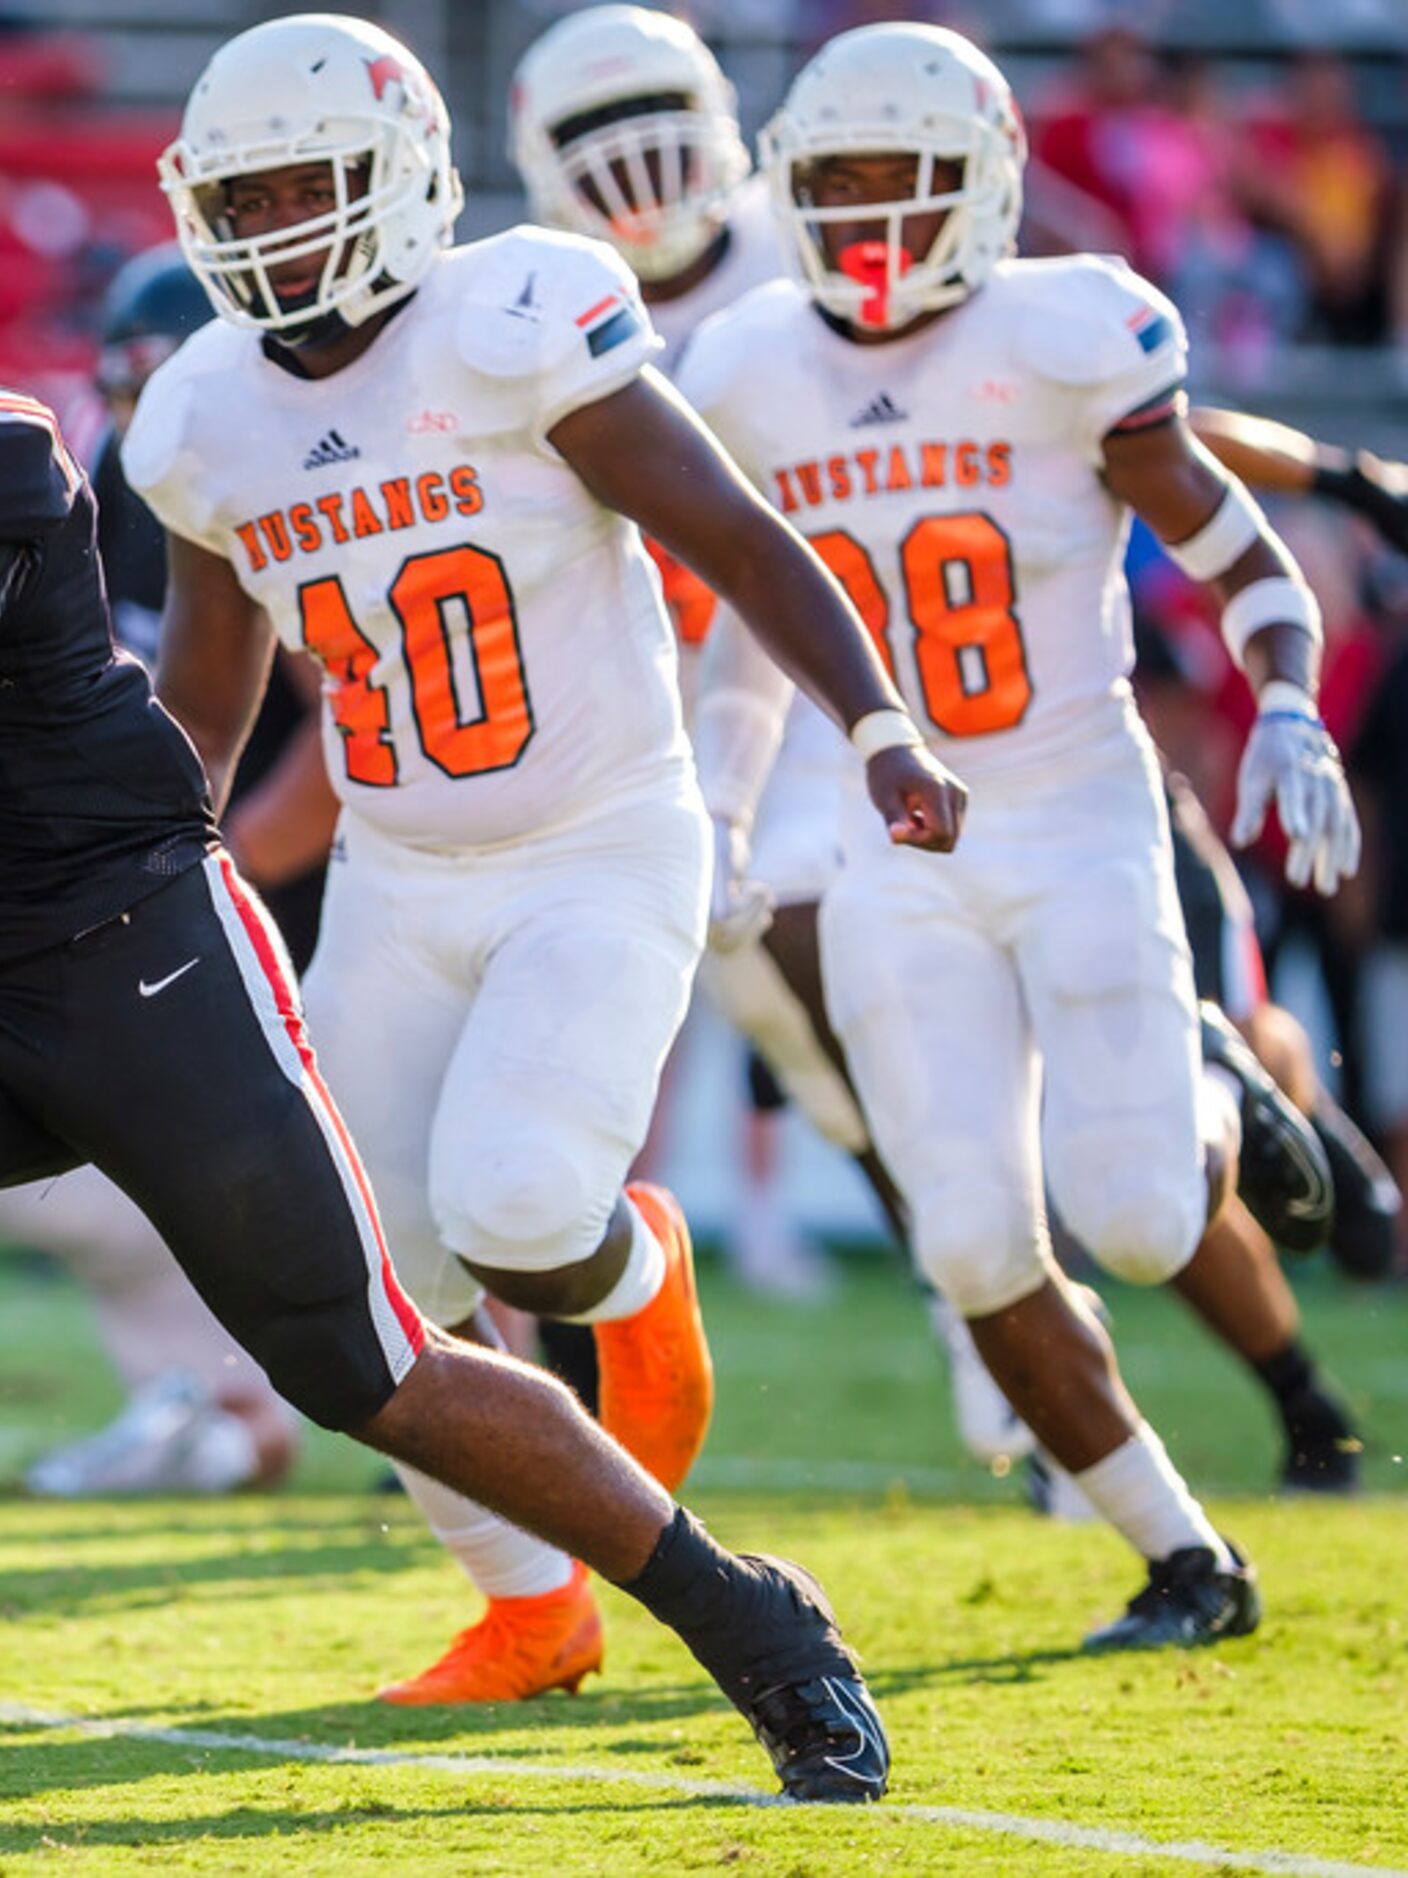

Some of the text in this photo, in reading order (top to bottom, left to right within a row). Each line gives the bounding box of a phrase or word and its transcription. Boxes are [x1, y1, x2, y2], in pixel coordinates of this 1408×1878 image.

[234, 465, 485, 573] MUSTANGS
[774, 441, 1013, 514] MUSTANGS
[297, 541, 537, 787] 40
